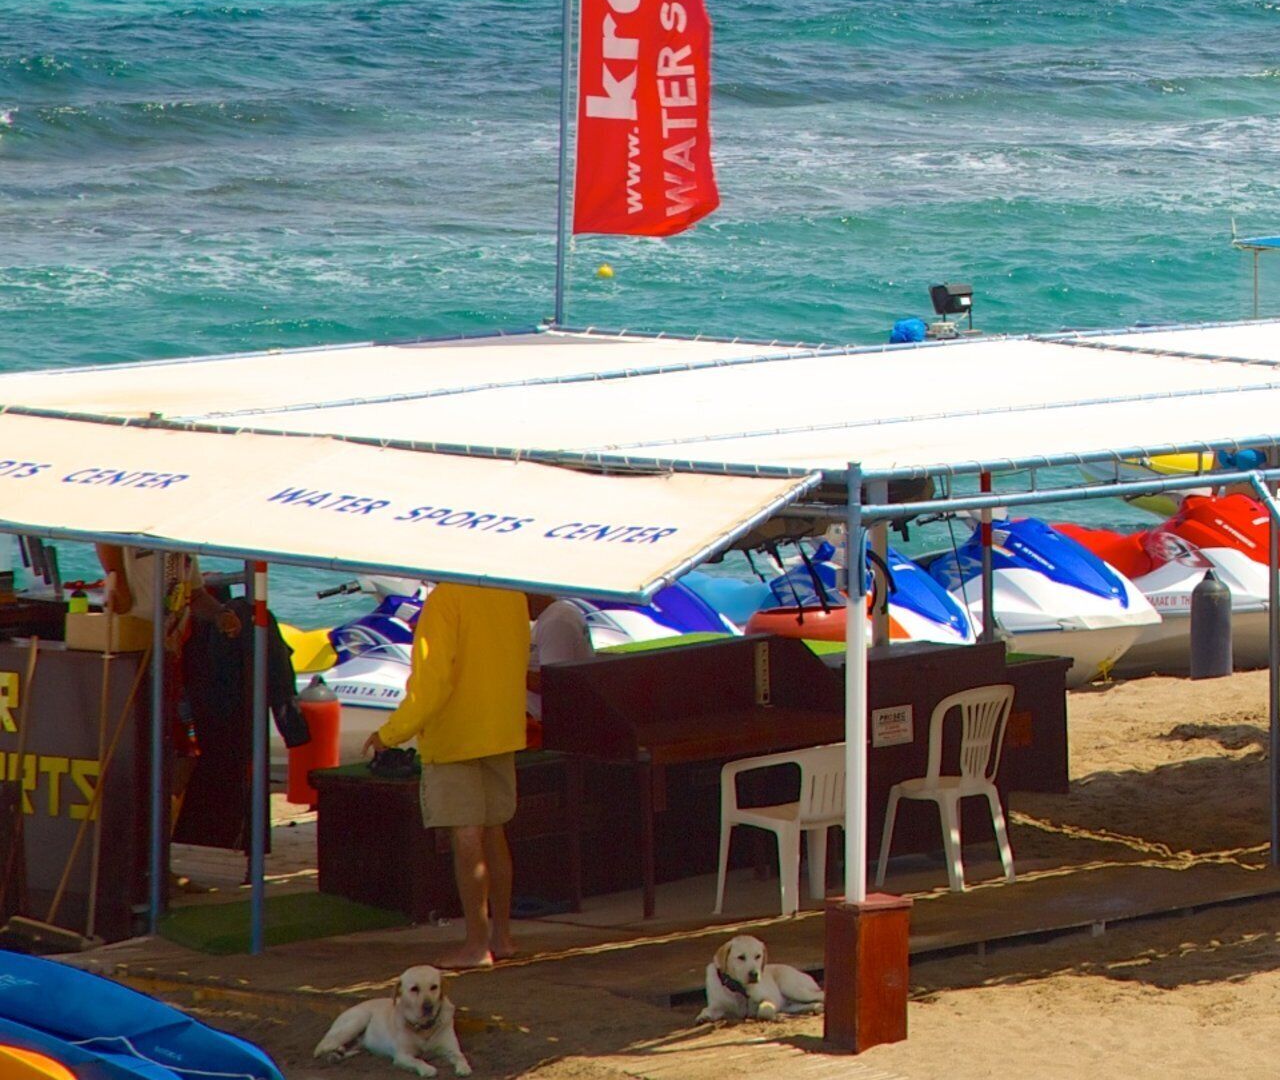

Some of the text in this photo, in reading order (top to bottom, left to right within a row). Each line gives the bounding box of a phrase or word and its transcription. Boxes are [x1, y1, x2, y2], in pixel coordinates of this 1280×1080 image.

[656, 44, 699, 217] WATER
[61, 468, 191, 490] CENTER
[266, 486, 679, 545] WATER SPORTS CENTER
